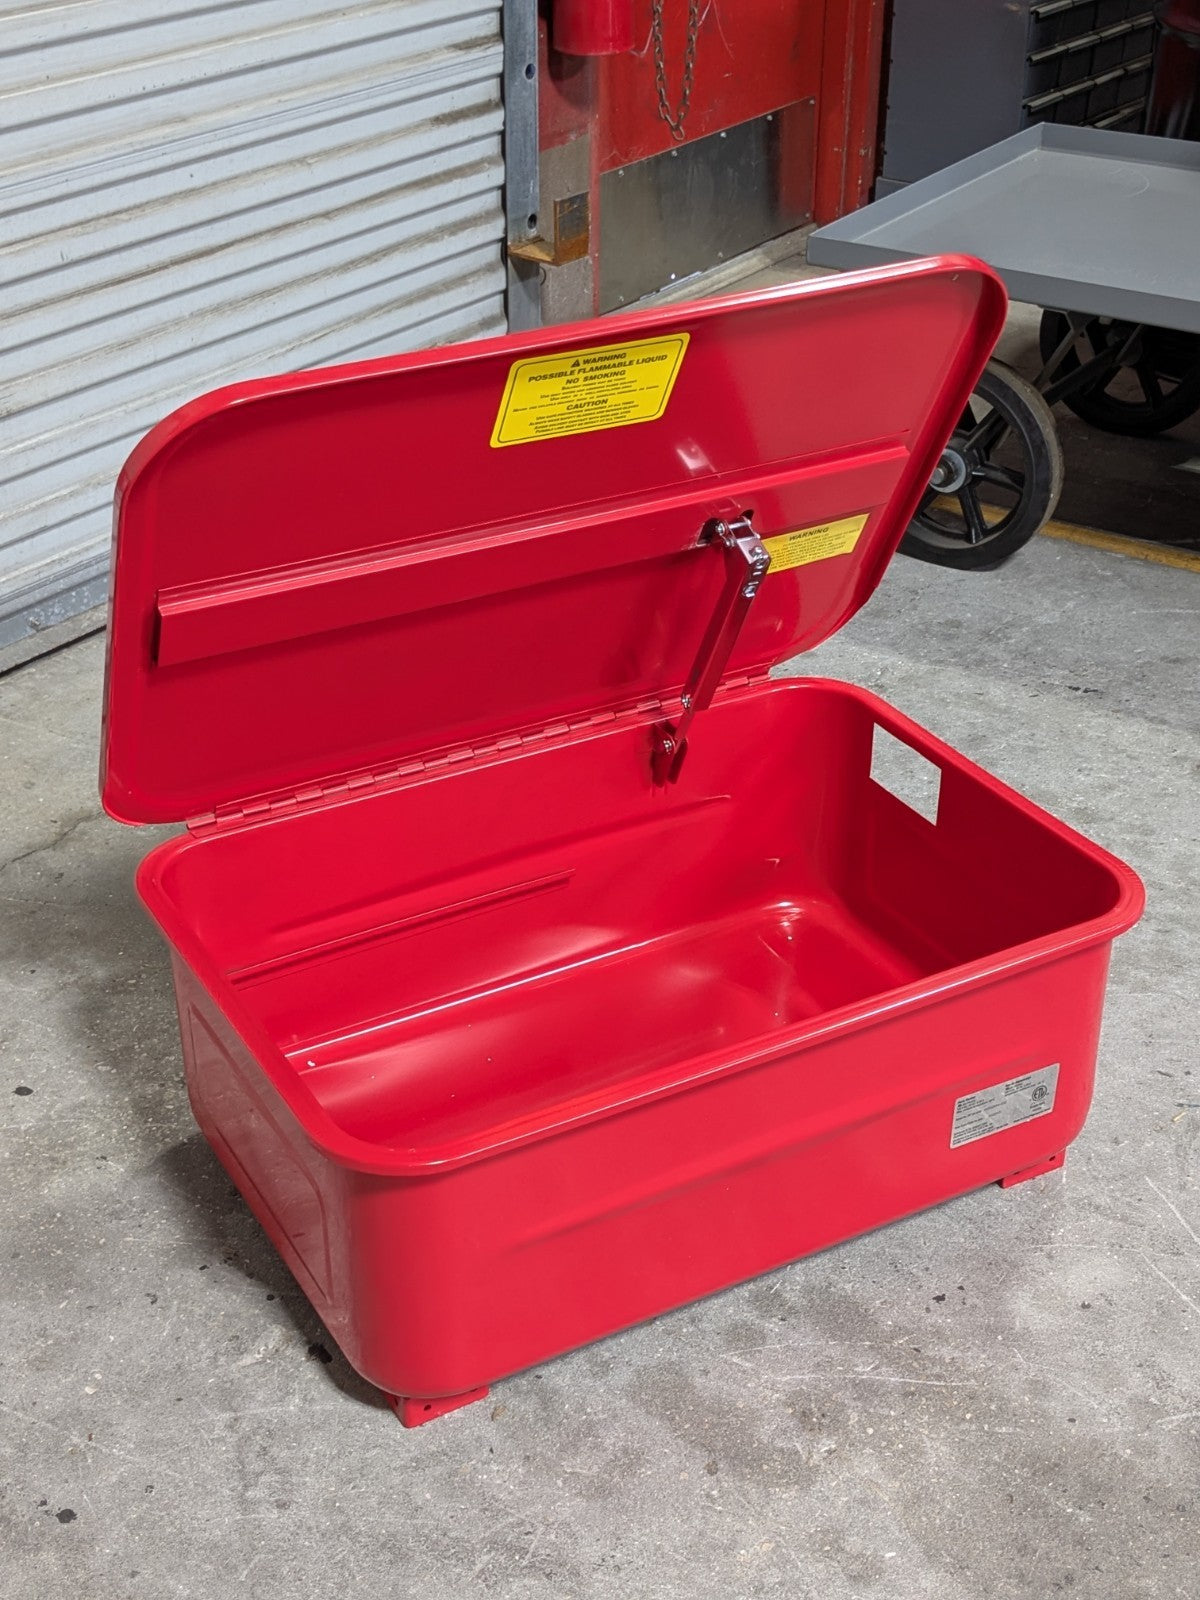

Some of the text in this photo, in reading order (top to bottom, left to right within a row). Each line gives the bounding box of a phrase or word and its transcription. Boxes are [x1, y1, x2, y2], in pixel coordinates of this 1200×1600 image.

[582, 353, 627, 365] WARNING
[528, 355, 668, 382] POSSIBLE FLAMMABLE LIQUID
[583, 370, 626, 381] SMOKING
[566, 398, 609, 411] CAUTION
[789, 527, 830, 541] WARNING
